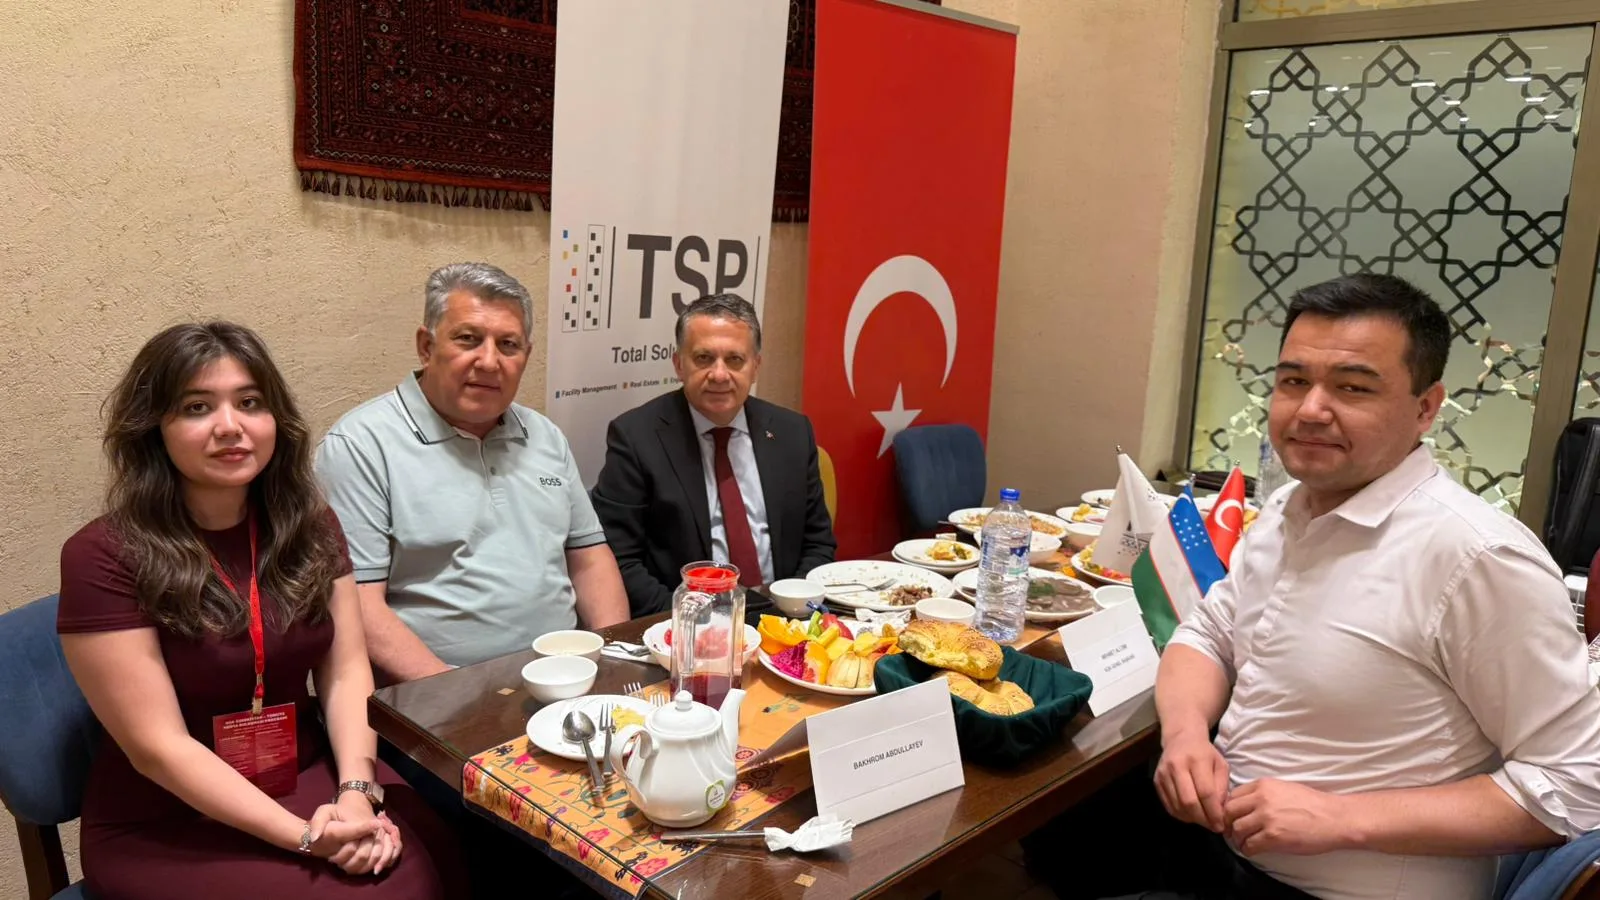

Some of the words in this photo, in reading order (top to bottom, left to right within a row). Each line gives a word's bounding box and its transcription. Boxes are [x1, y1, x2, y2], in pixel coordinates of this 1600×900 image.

[627, 234, 749, 319] TSP
[611, 345, 647, 363] Total
[561, 389, 581, 397] Facility
[582, 383, 617, 394] Management
[643, 379, 659, 387] Estate
[539, 477, 562, 486] BOSS
[853, 753, 885, 770] BAKHROM
[885, 740, 923, 758] ABDULLAYEV
